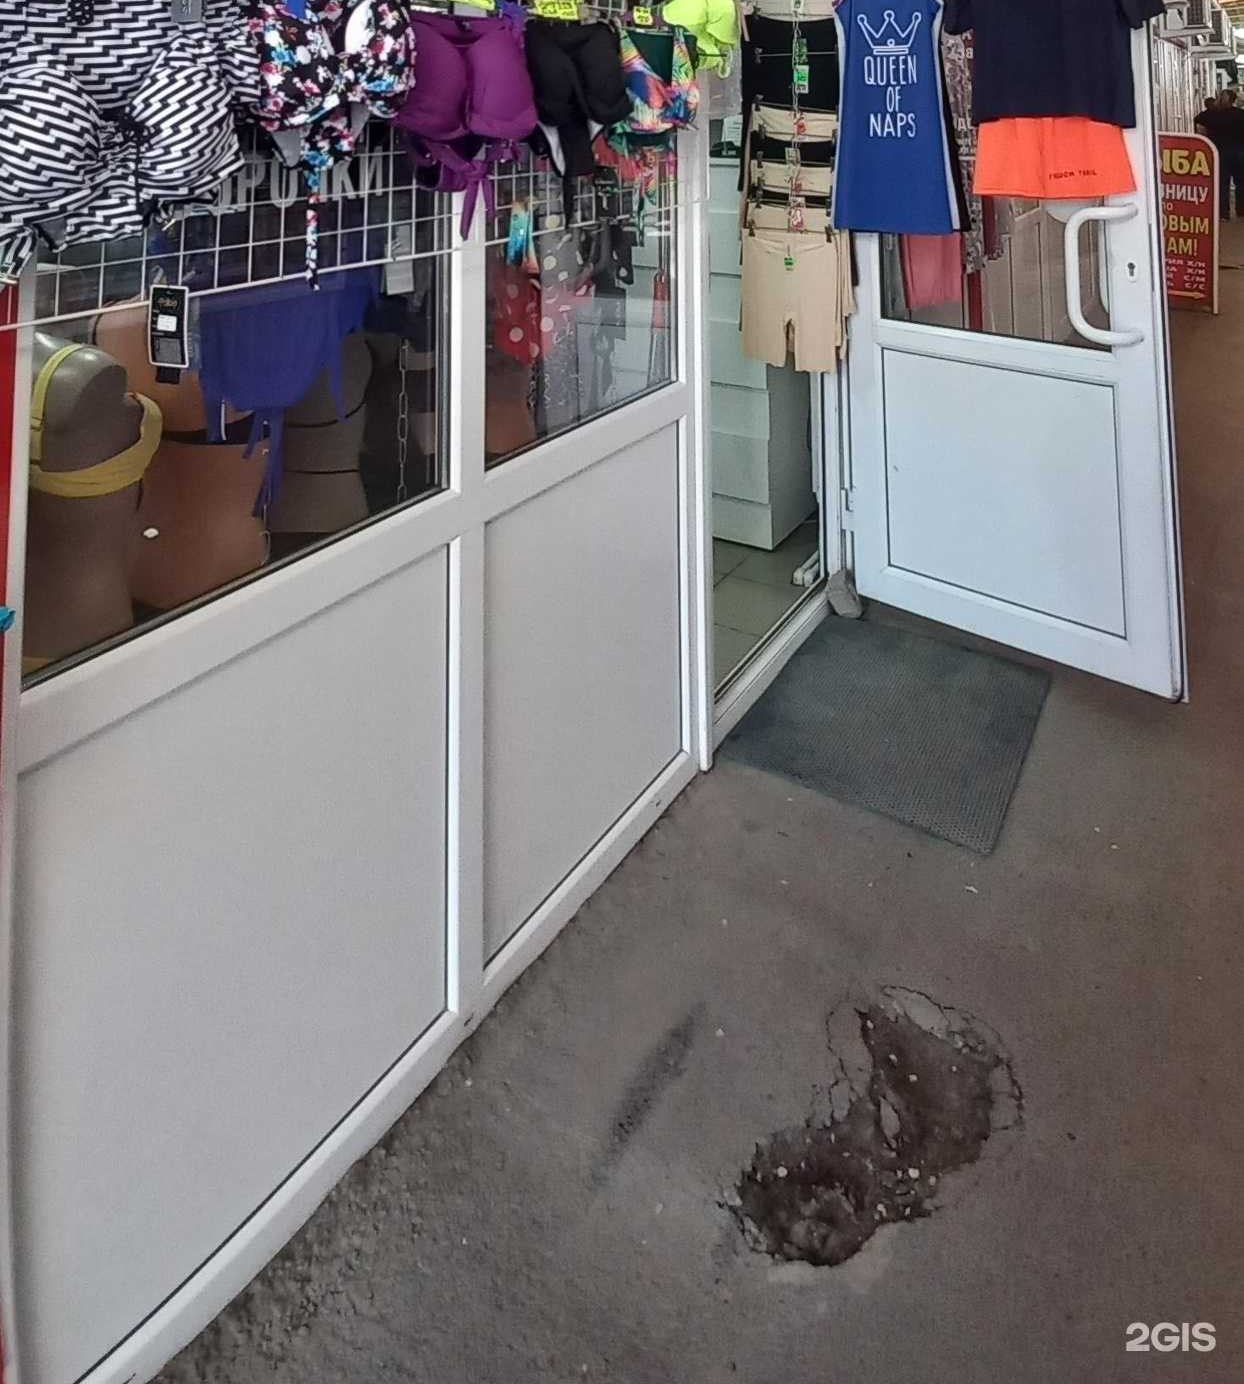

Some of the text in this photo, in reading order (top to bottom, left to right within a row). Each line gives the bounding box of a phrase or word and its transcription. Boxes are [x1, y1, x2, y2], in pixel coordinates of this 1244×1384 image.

[864, 55, 917, 85] QUEEN
[886, 86, 901, 113] OF
[869, 113, 916, 138] NAPS
